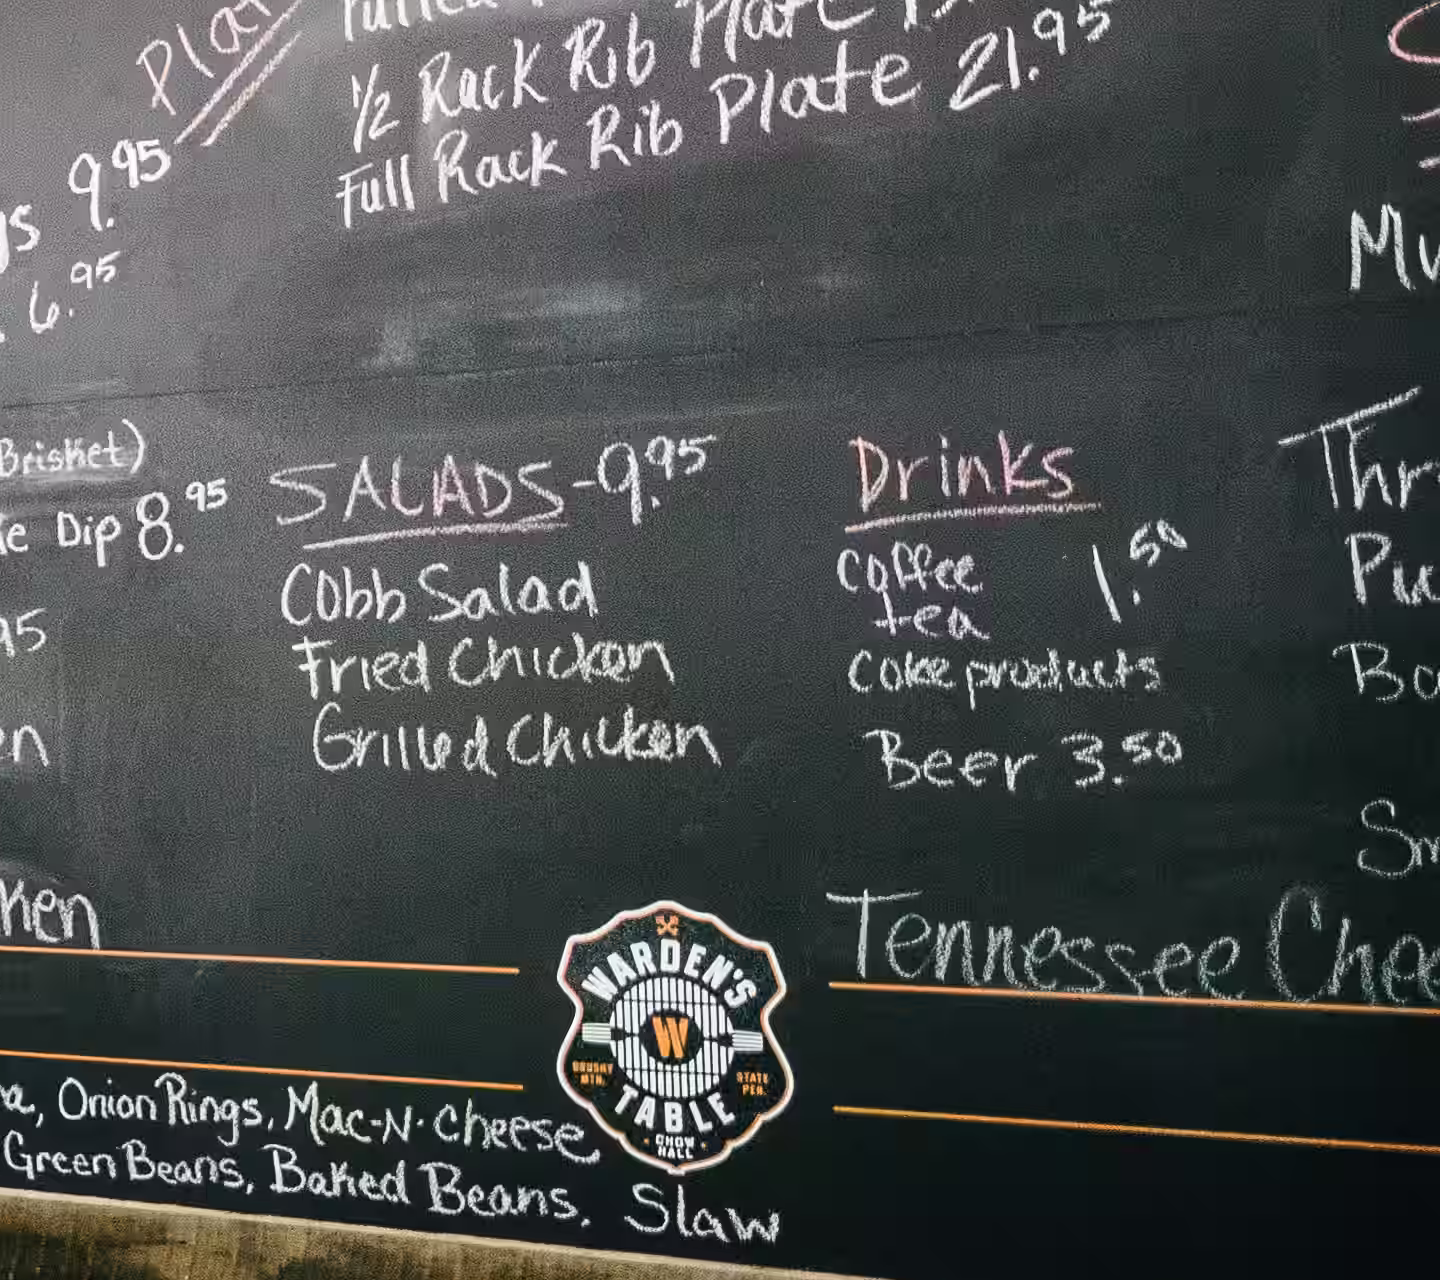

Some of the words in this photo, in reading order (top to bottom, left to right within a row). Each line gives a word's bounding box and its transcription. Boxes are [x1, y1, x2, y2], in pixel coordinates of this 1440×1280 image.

[419, 38, 549, 123] Rack
[562, 12, 657, 92] Rib
[334, 154, 415, 228] Full
[433, 129, 568, 203] Rack
[586, 100, 683, 169] Rib
[709, 40, 923, 144] Plate
[269, 455, 565, 525] SALADS
[848, 429, 1075, 513] Drinks
[56, 509, 121, 567] Dip
[281, 563, 406, 625] Cobb
[418, 560, 599, 622] Salad
[874, 592, 990, 640] tea
[291, 635, 430, 700] Fried
[448, 632, 676, 690] Chicken
[966, 648, 1161, 711] products
[312, 701, 498, 778] Grilled
[506, 703, 723, 770] Chicken
[861, 729, 1038, 792] Beer
[582, 938, 757, 1008] WARDEN'S
[826, 888, 1245, 1001] Tennessee
[651, 1016, 689, 1058] W
[57, 1077, 158, 1122] Onion
[614, 1084, 735, 1133] TABLE
[655, 1133, 695, 1148] CHOW
[657, 1146, 694, 1160] HALL
[3, 1130, 117, 1180] Green
[262, 1143, 411, 1205] Baked
[624, 1182, 781, 1245] Slaw
